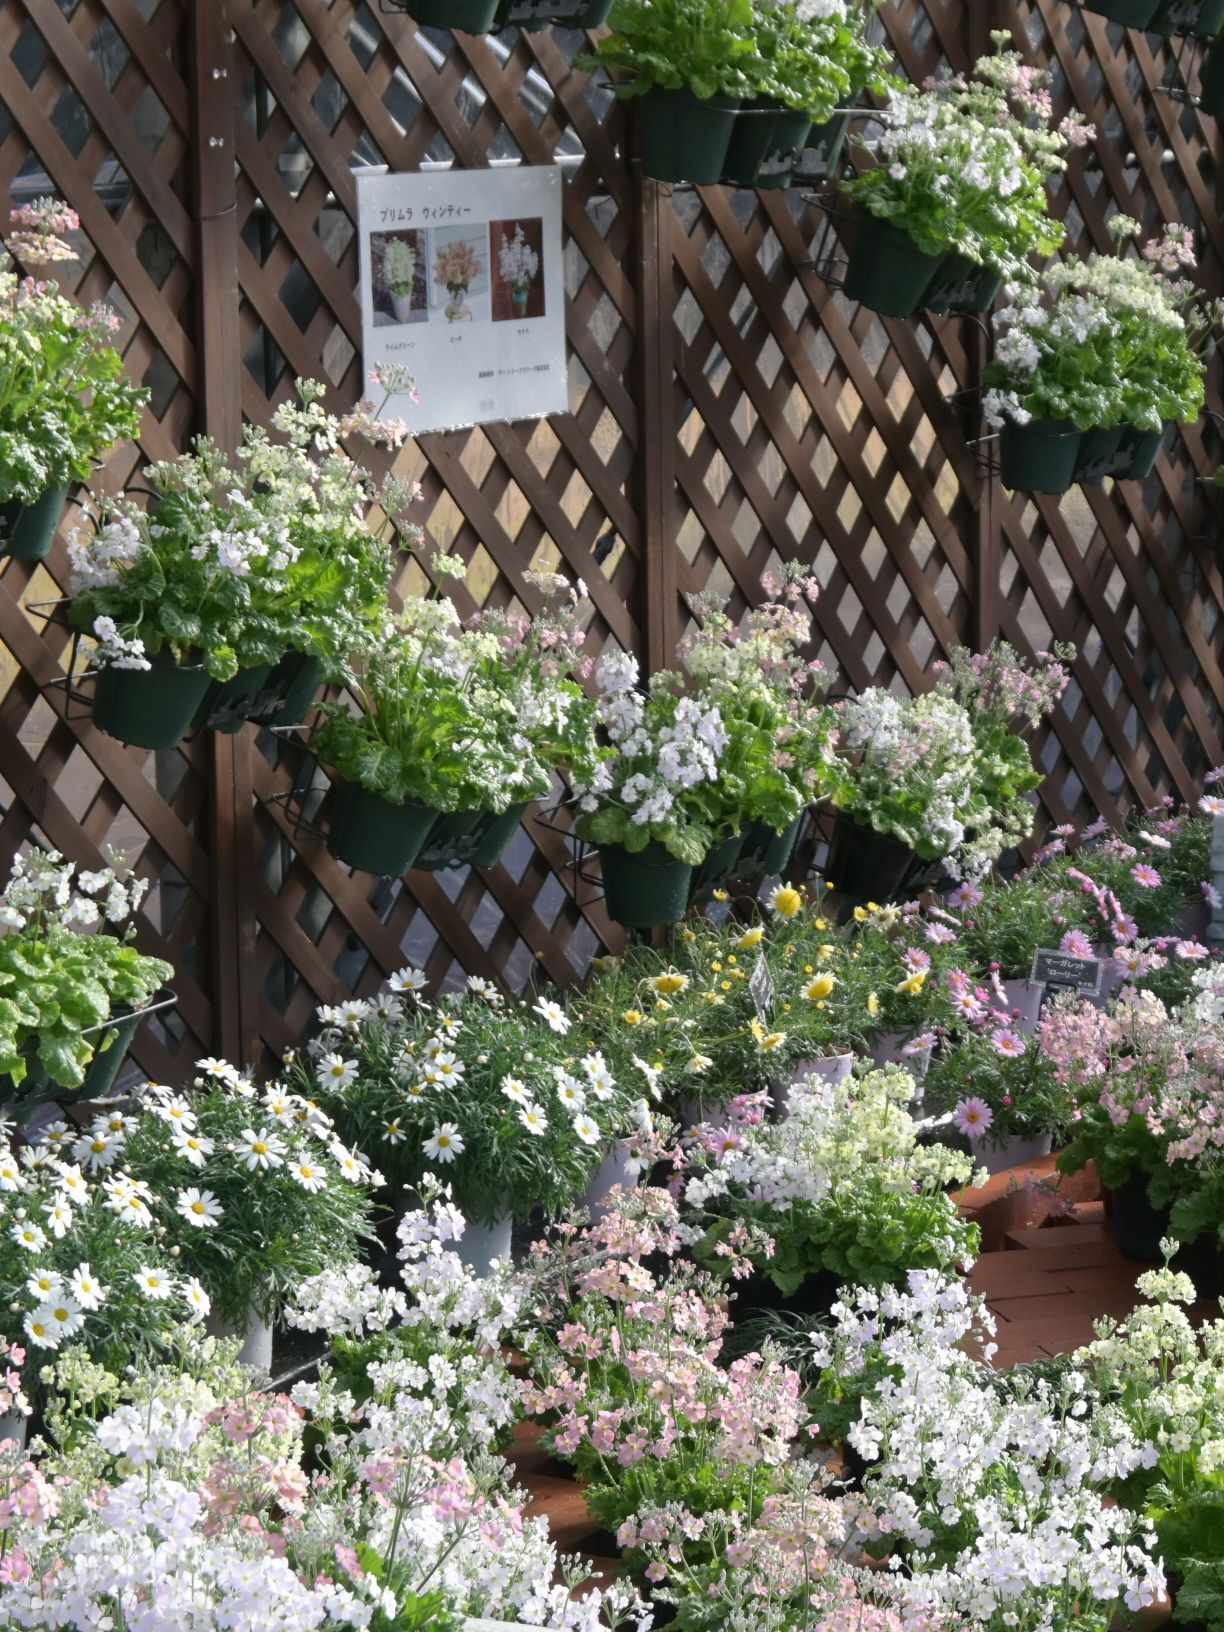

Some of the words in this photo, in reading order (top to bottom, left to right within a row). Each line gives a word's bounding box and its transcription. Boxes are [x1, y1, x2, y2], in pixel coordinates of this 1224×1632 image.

[422, 204, 471, 219] ウィンティー
[1046, 958, 1086, 969] マーガレット
